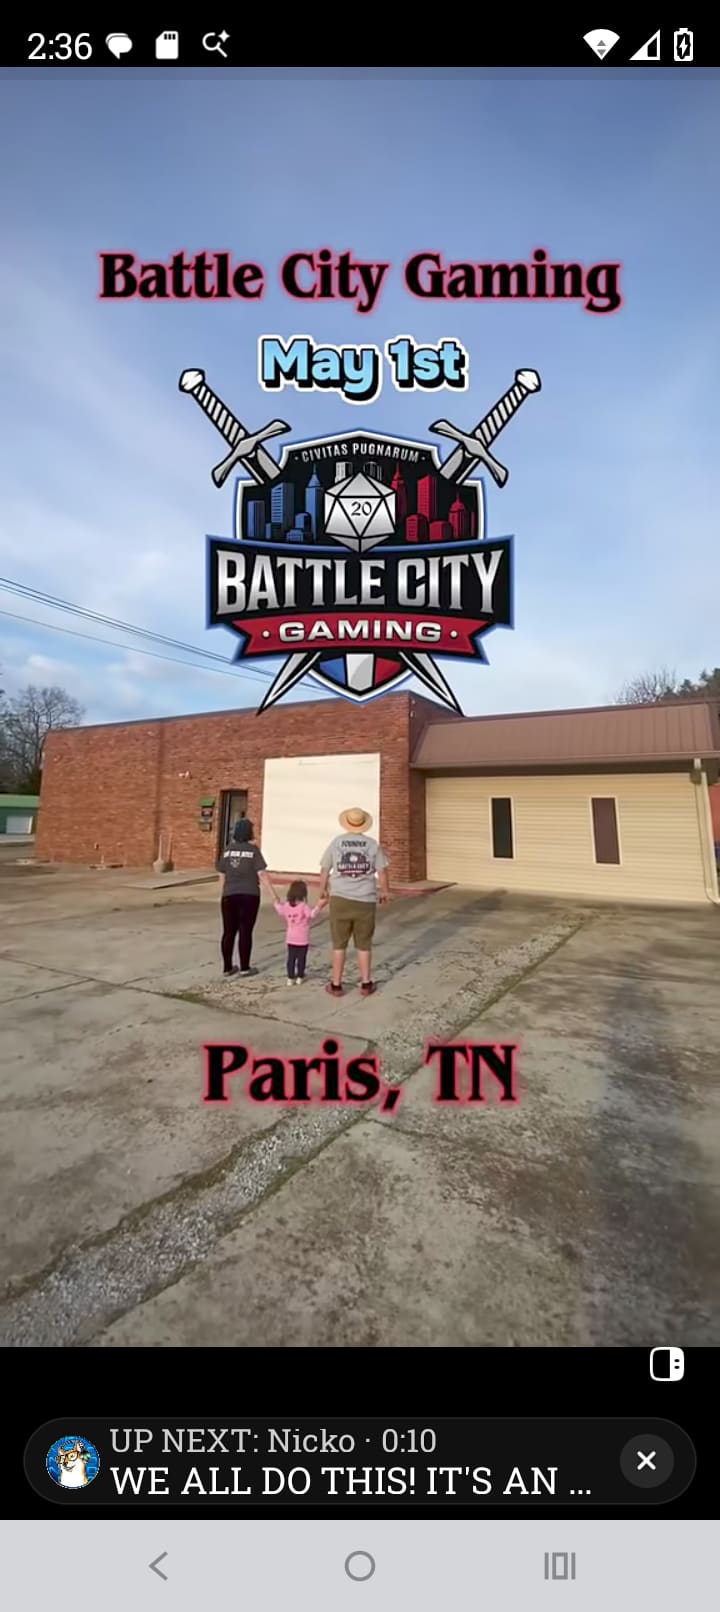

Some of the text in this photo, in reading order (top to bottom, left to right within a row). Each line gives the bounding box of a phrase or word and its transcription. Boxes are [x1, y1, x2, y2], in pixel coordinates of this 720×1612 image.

[27, 32, 93, 61] 2:36
[109, 1428, 437, 1453] UP NEXT: Nicko 0:10
[109, 1466, 170, 1495] WE
[180, 1466, 252, 1495] ALL
[261, 1466, 311, 1495] DO
[320, 1466, 415, 1495] THIS!
[426, 1466, 492, 1495] IT'S
[502, 1466, 559, 1495] AN
